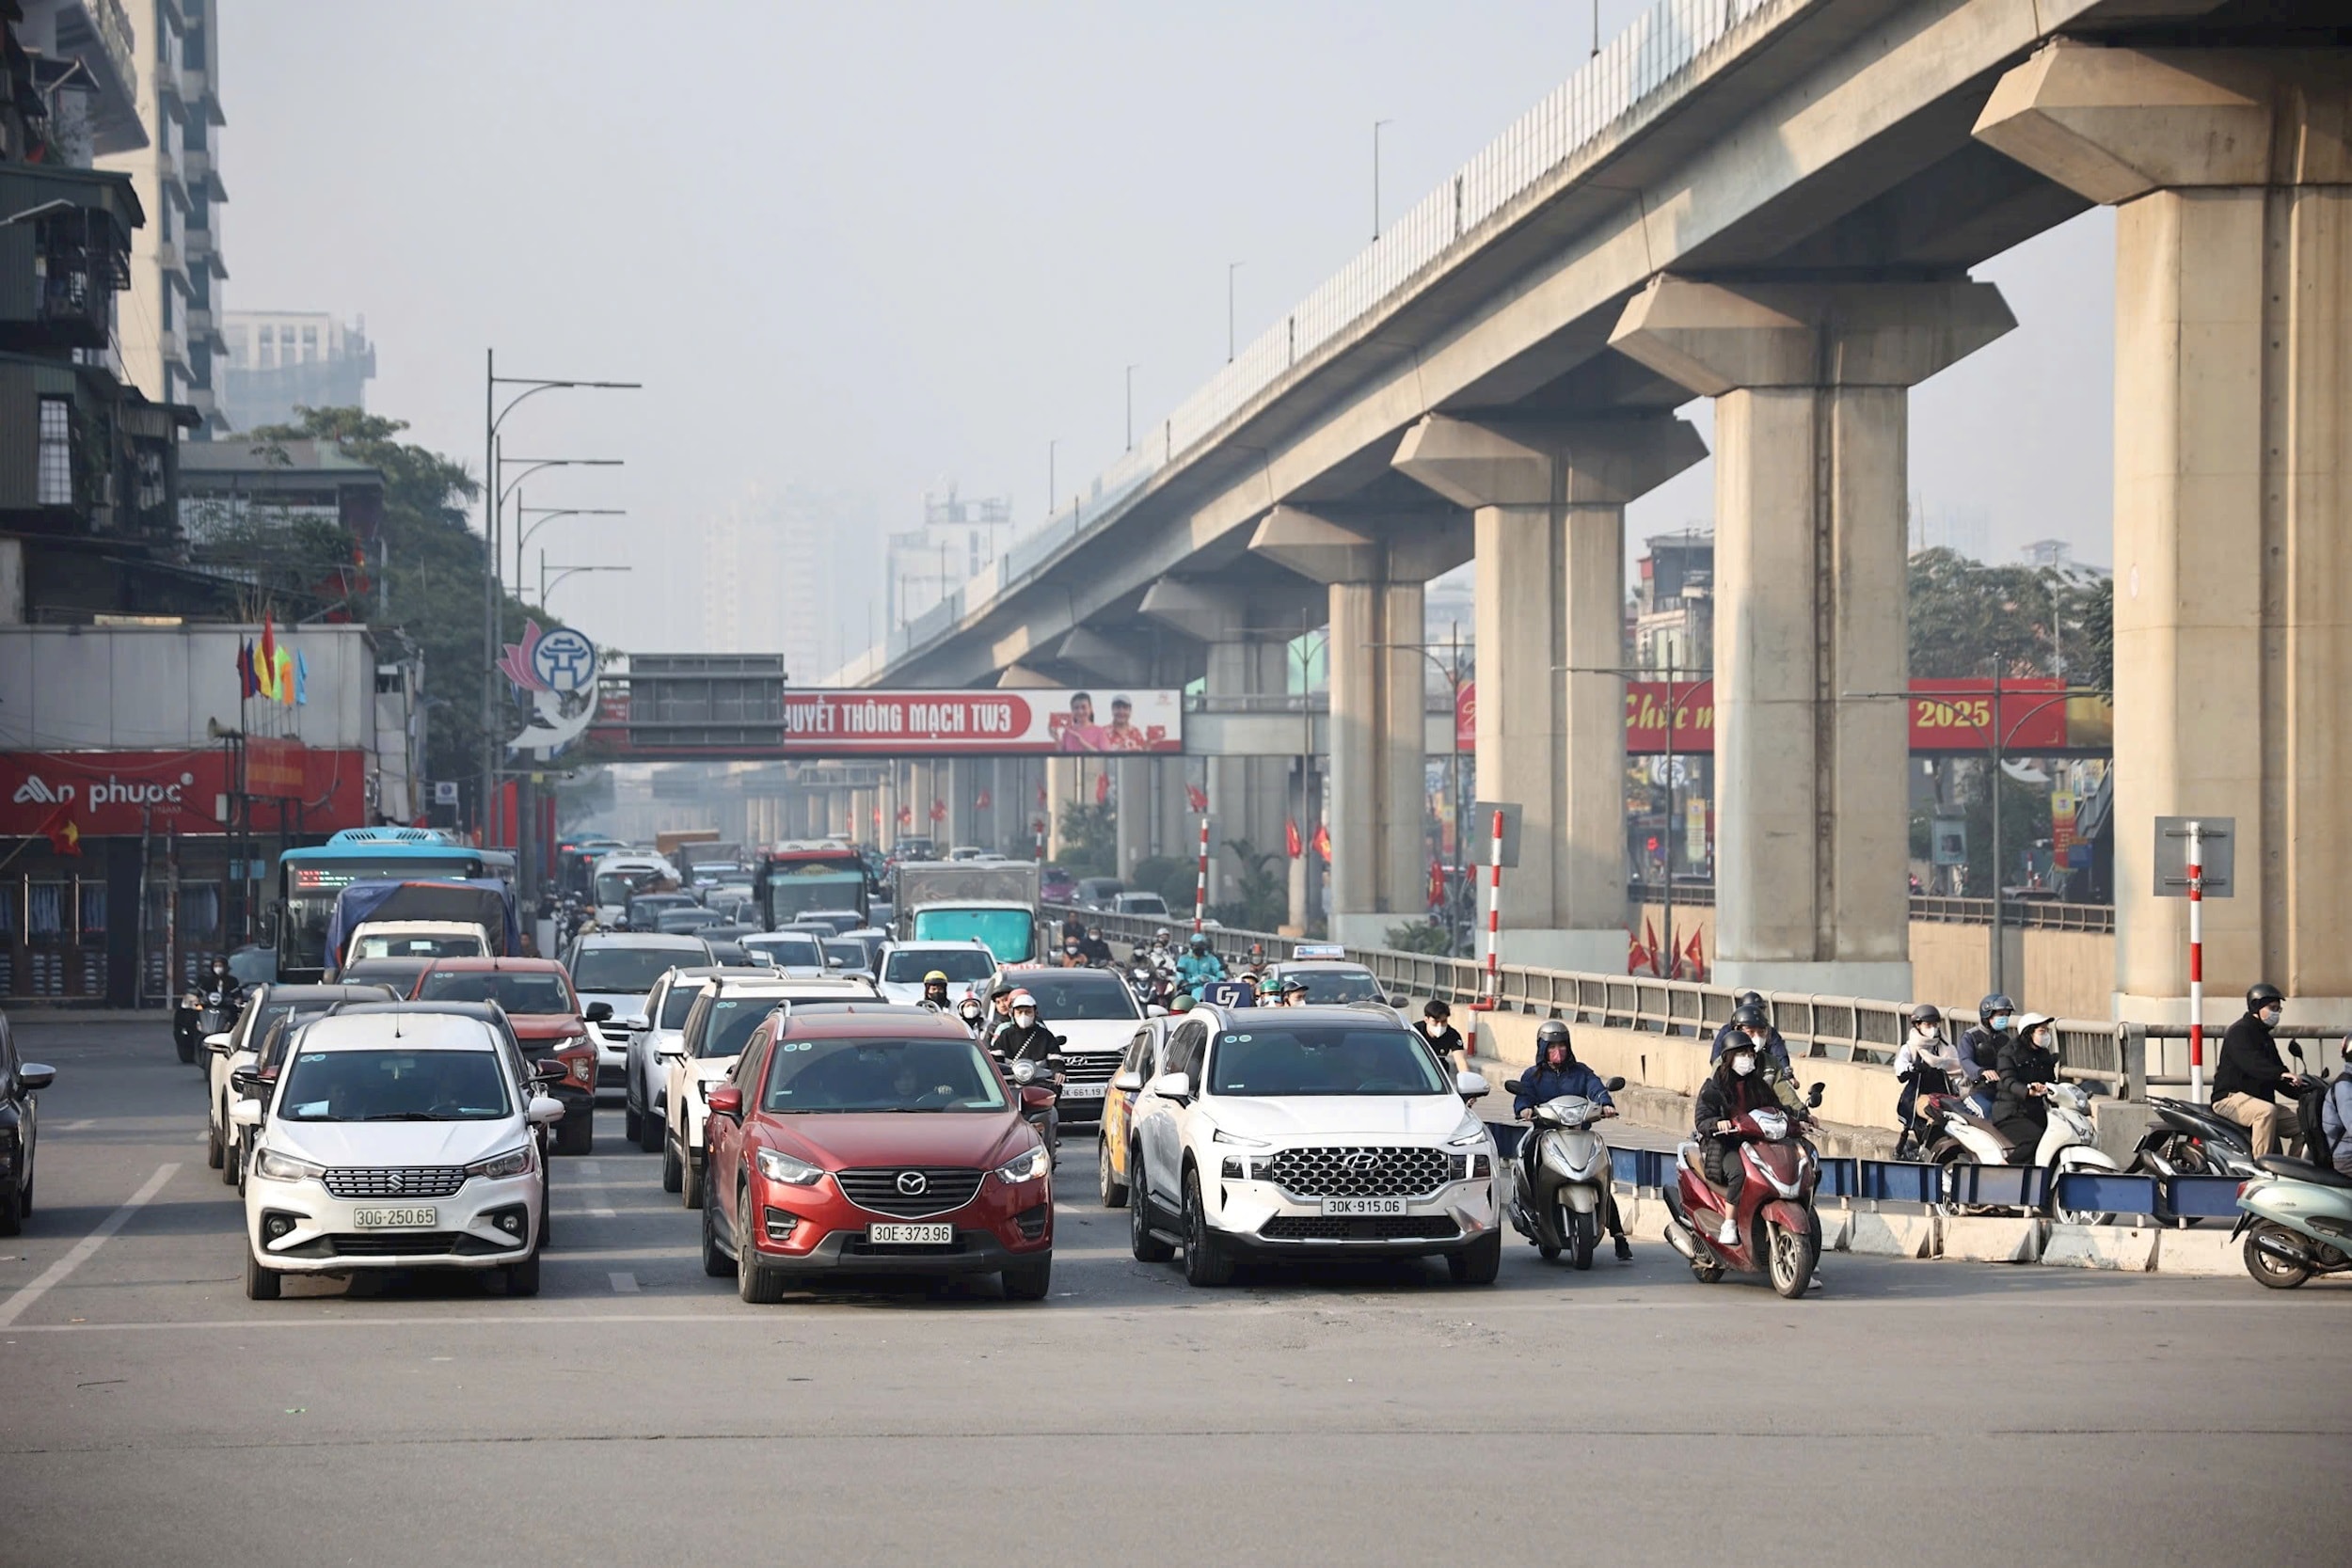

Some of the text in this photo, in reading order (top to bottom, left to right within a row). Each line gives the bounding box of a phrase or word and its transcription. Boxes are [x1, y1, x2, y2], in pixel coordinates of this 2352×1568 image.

[841, 699, 902, 733] THÔNG
[909, 703, 965, 739] MẠCH
[970, 703, 1012, 733] TW3
[1916, 700, 1991, 728] 2025
[1329, 1200, 1400, 1212] 30K-915.06
[357, 1210, 434, 1226] 30G-250.65
[874, 1226, 949, 1242] 30E-373.96
